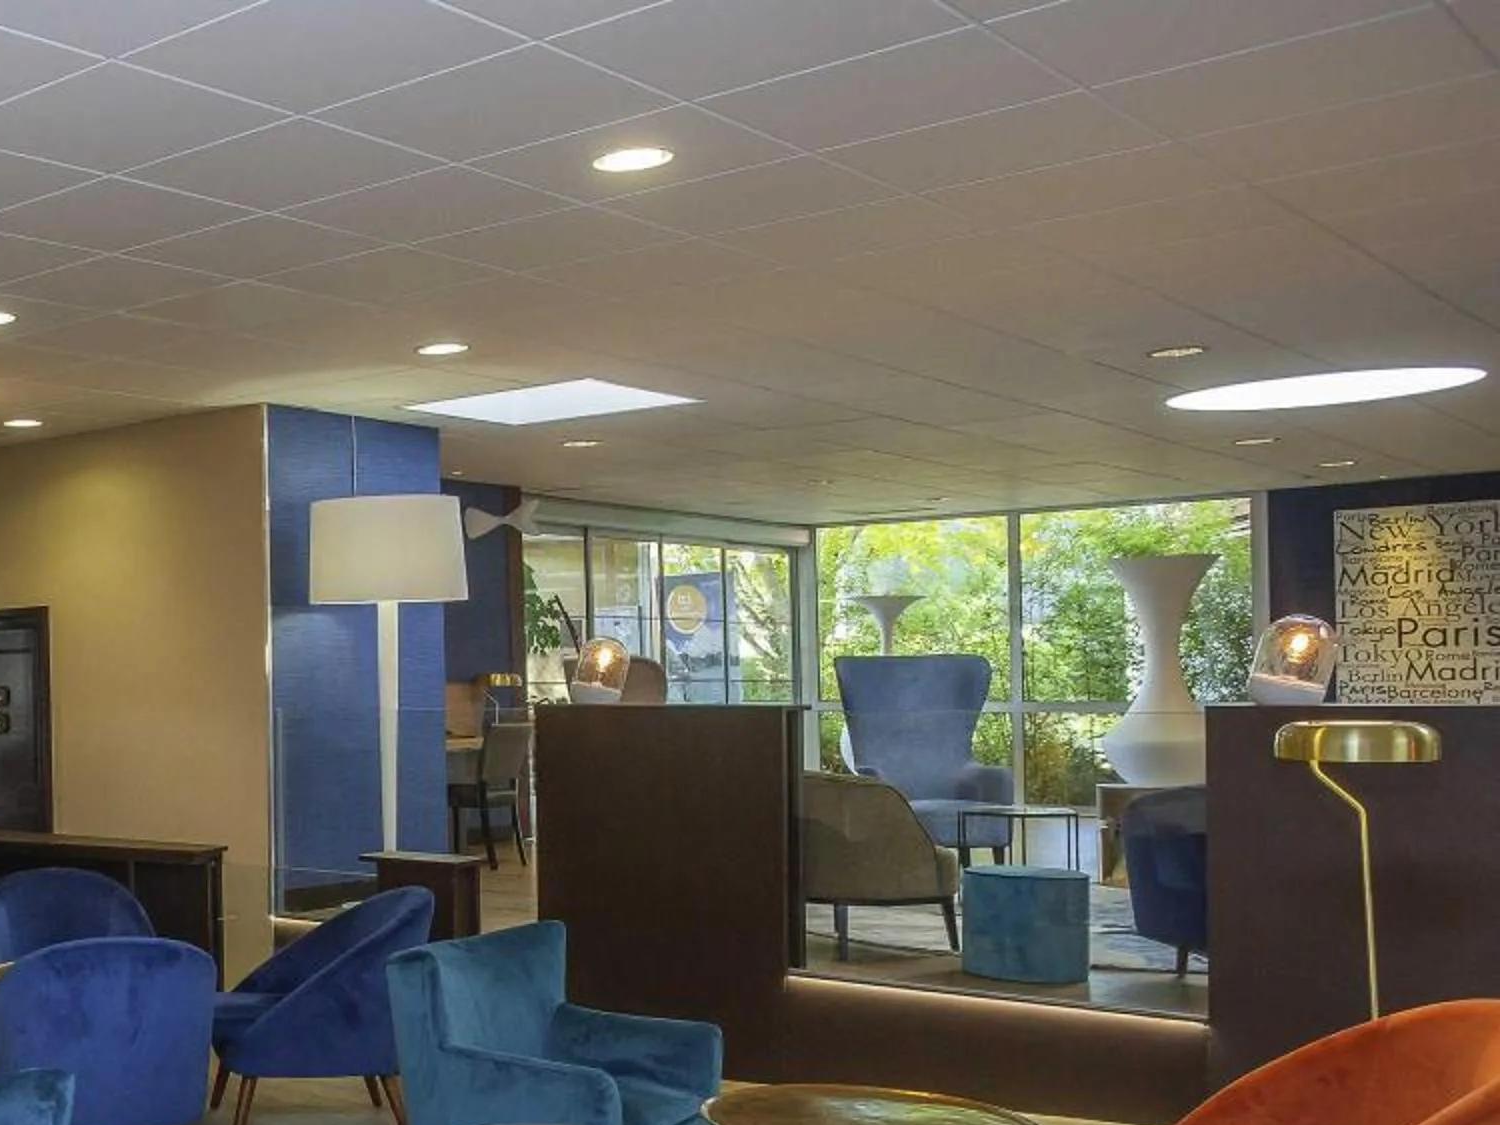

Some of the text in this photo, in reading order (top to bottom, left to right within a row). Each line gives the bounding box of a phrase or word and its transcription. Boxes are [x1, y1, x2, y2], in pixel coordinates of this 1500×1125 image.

[1368, 511, 1427, 526] Berlin
[1336, 540, 1427, 555] Londres
[1339, 558, 1455, 587] Madrid
[1387, 585, 1425, 599] Los
[1341, 600, 1389, 619] Los
[1397, 617, 1500, 648] Paris
[1342, 643, 1423, 668] Tokyo
[1348, 669, 1403, 683] Berlin
